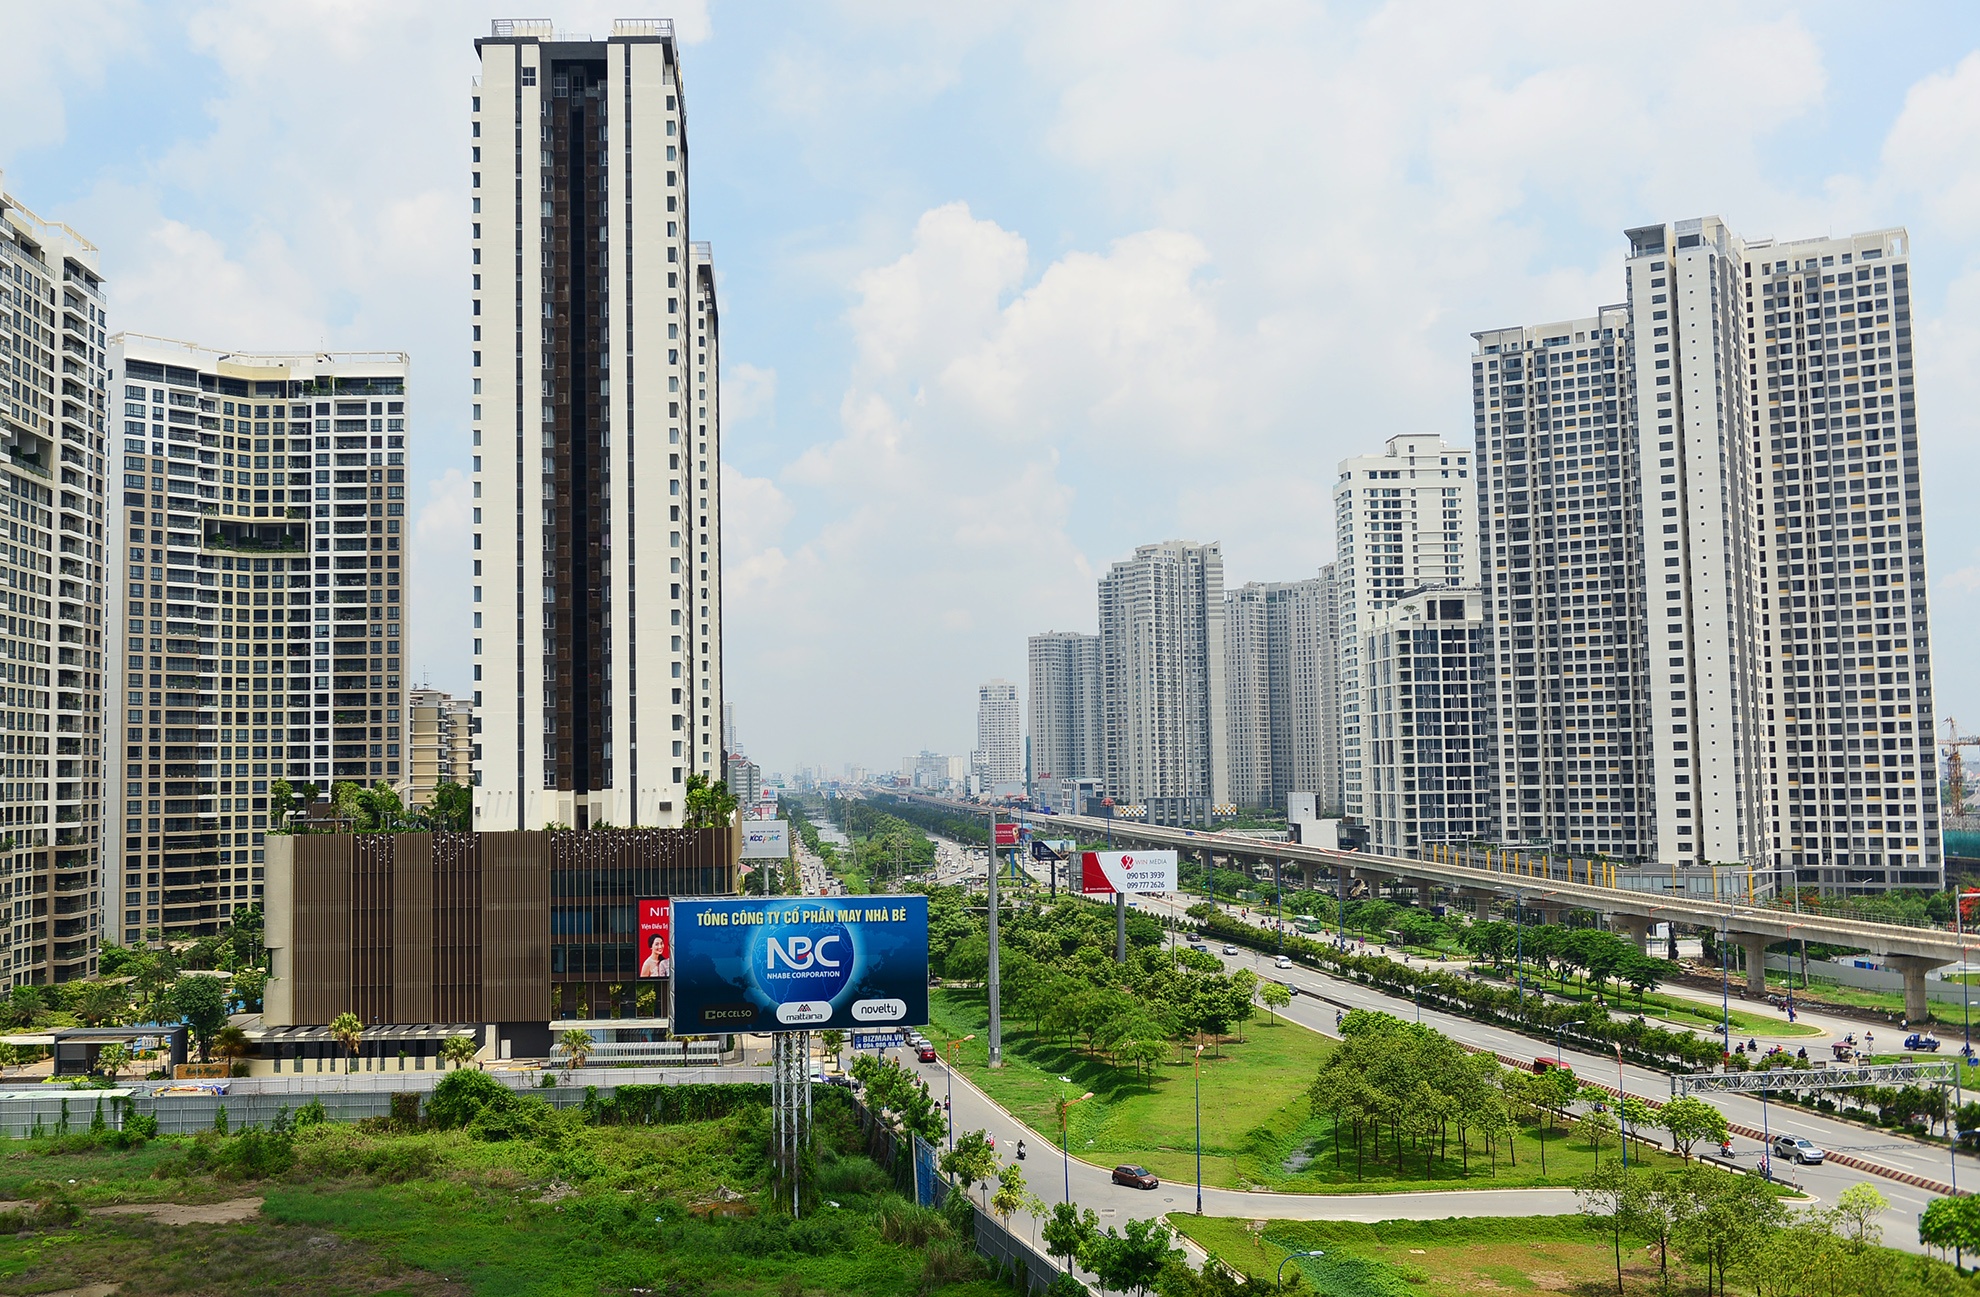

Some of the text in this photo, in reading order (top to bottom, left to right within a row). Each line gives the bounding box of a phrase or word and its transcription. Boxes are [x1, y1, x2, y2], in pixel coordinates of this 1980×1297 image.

[1126, 871, 1165, 880] 090 151 3939
[1126, 881, 1165, 889] 099 777 2626
[697, 906, 906, 926] TỔNG CÔNG TY CỔ PHẦN MAY NHÀ BÈ
[767, 935, 840, 970] NBC
[791, 971, 840, 979] CORPORATION
[861, 1003, 898, 1016] novelty
[786, 1012, 823, 1021] mattana
[862, 1034, 905, 1043] BIZMAN.VN
